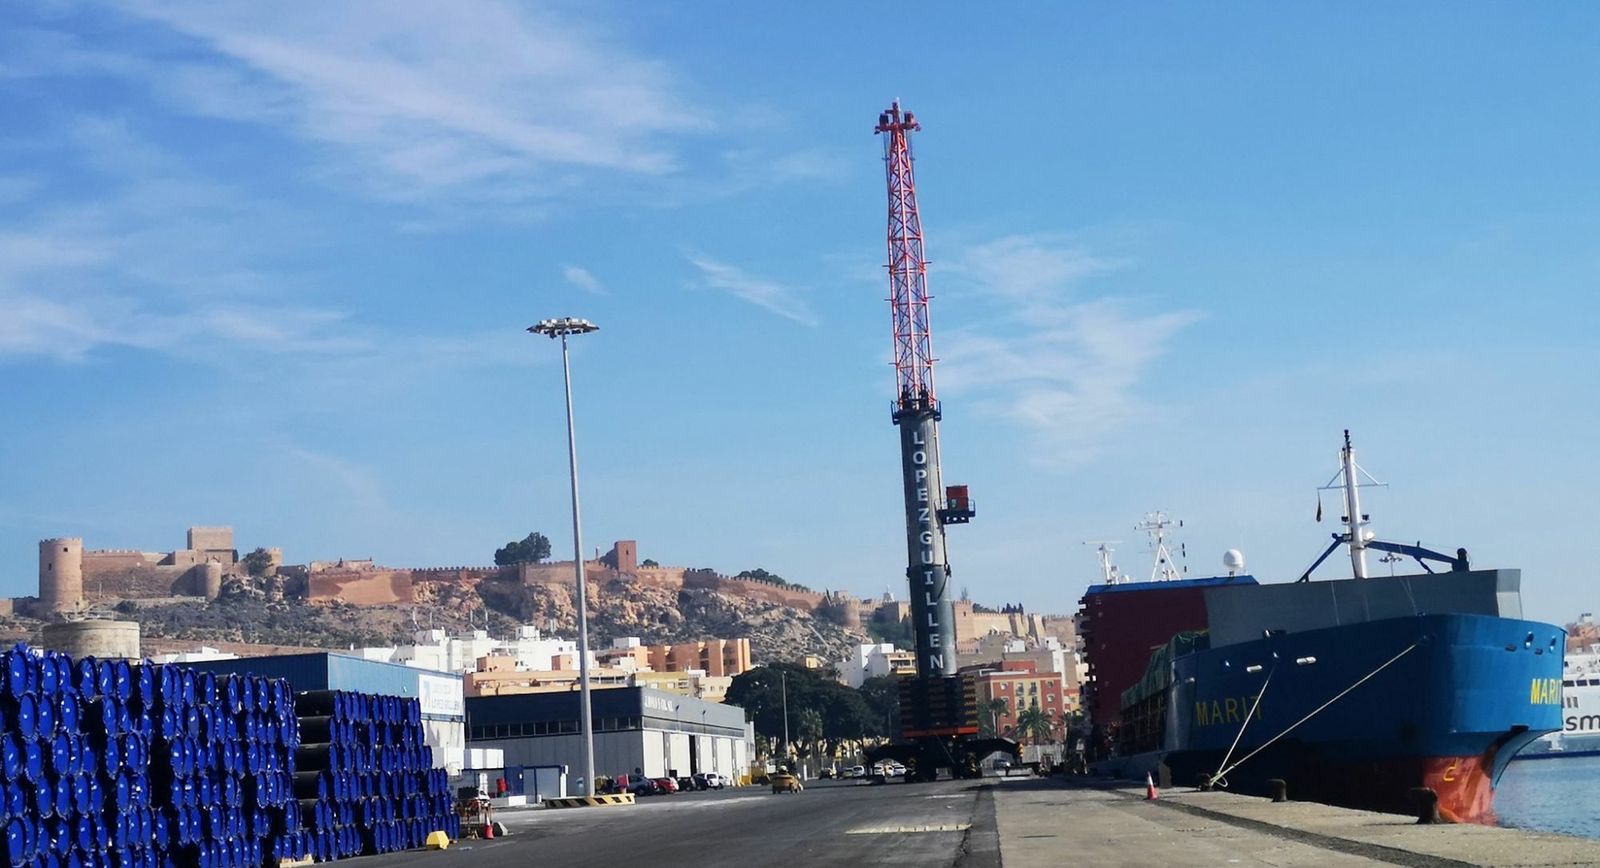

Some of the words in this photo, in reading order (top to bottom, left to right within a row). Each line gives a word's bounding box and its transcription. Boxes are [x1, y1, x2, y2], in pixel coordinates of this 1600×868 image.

[913, 431, 930, 521] LOPEZ
[920, 531, 944, 669] GUILLEN
[1195, 695, 1263, 727] MARIT
